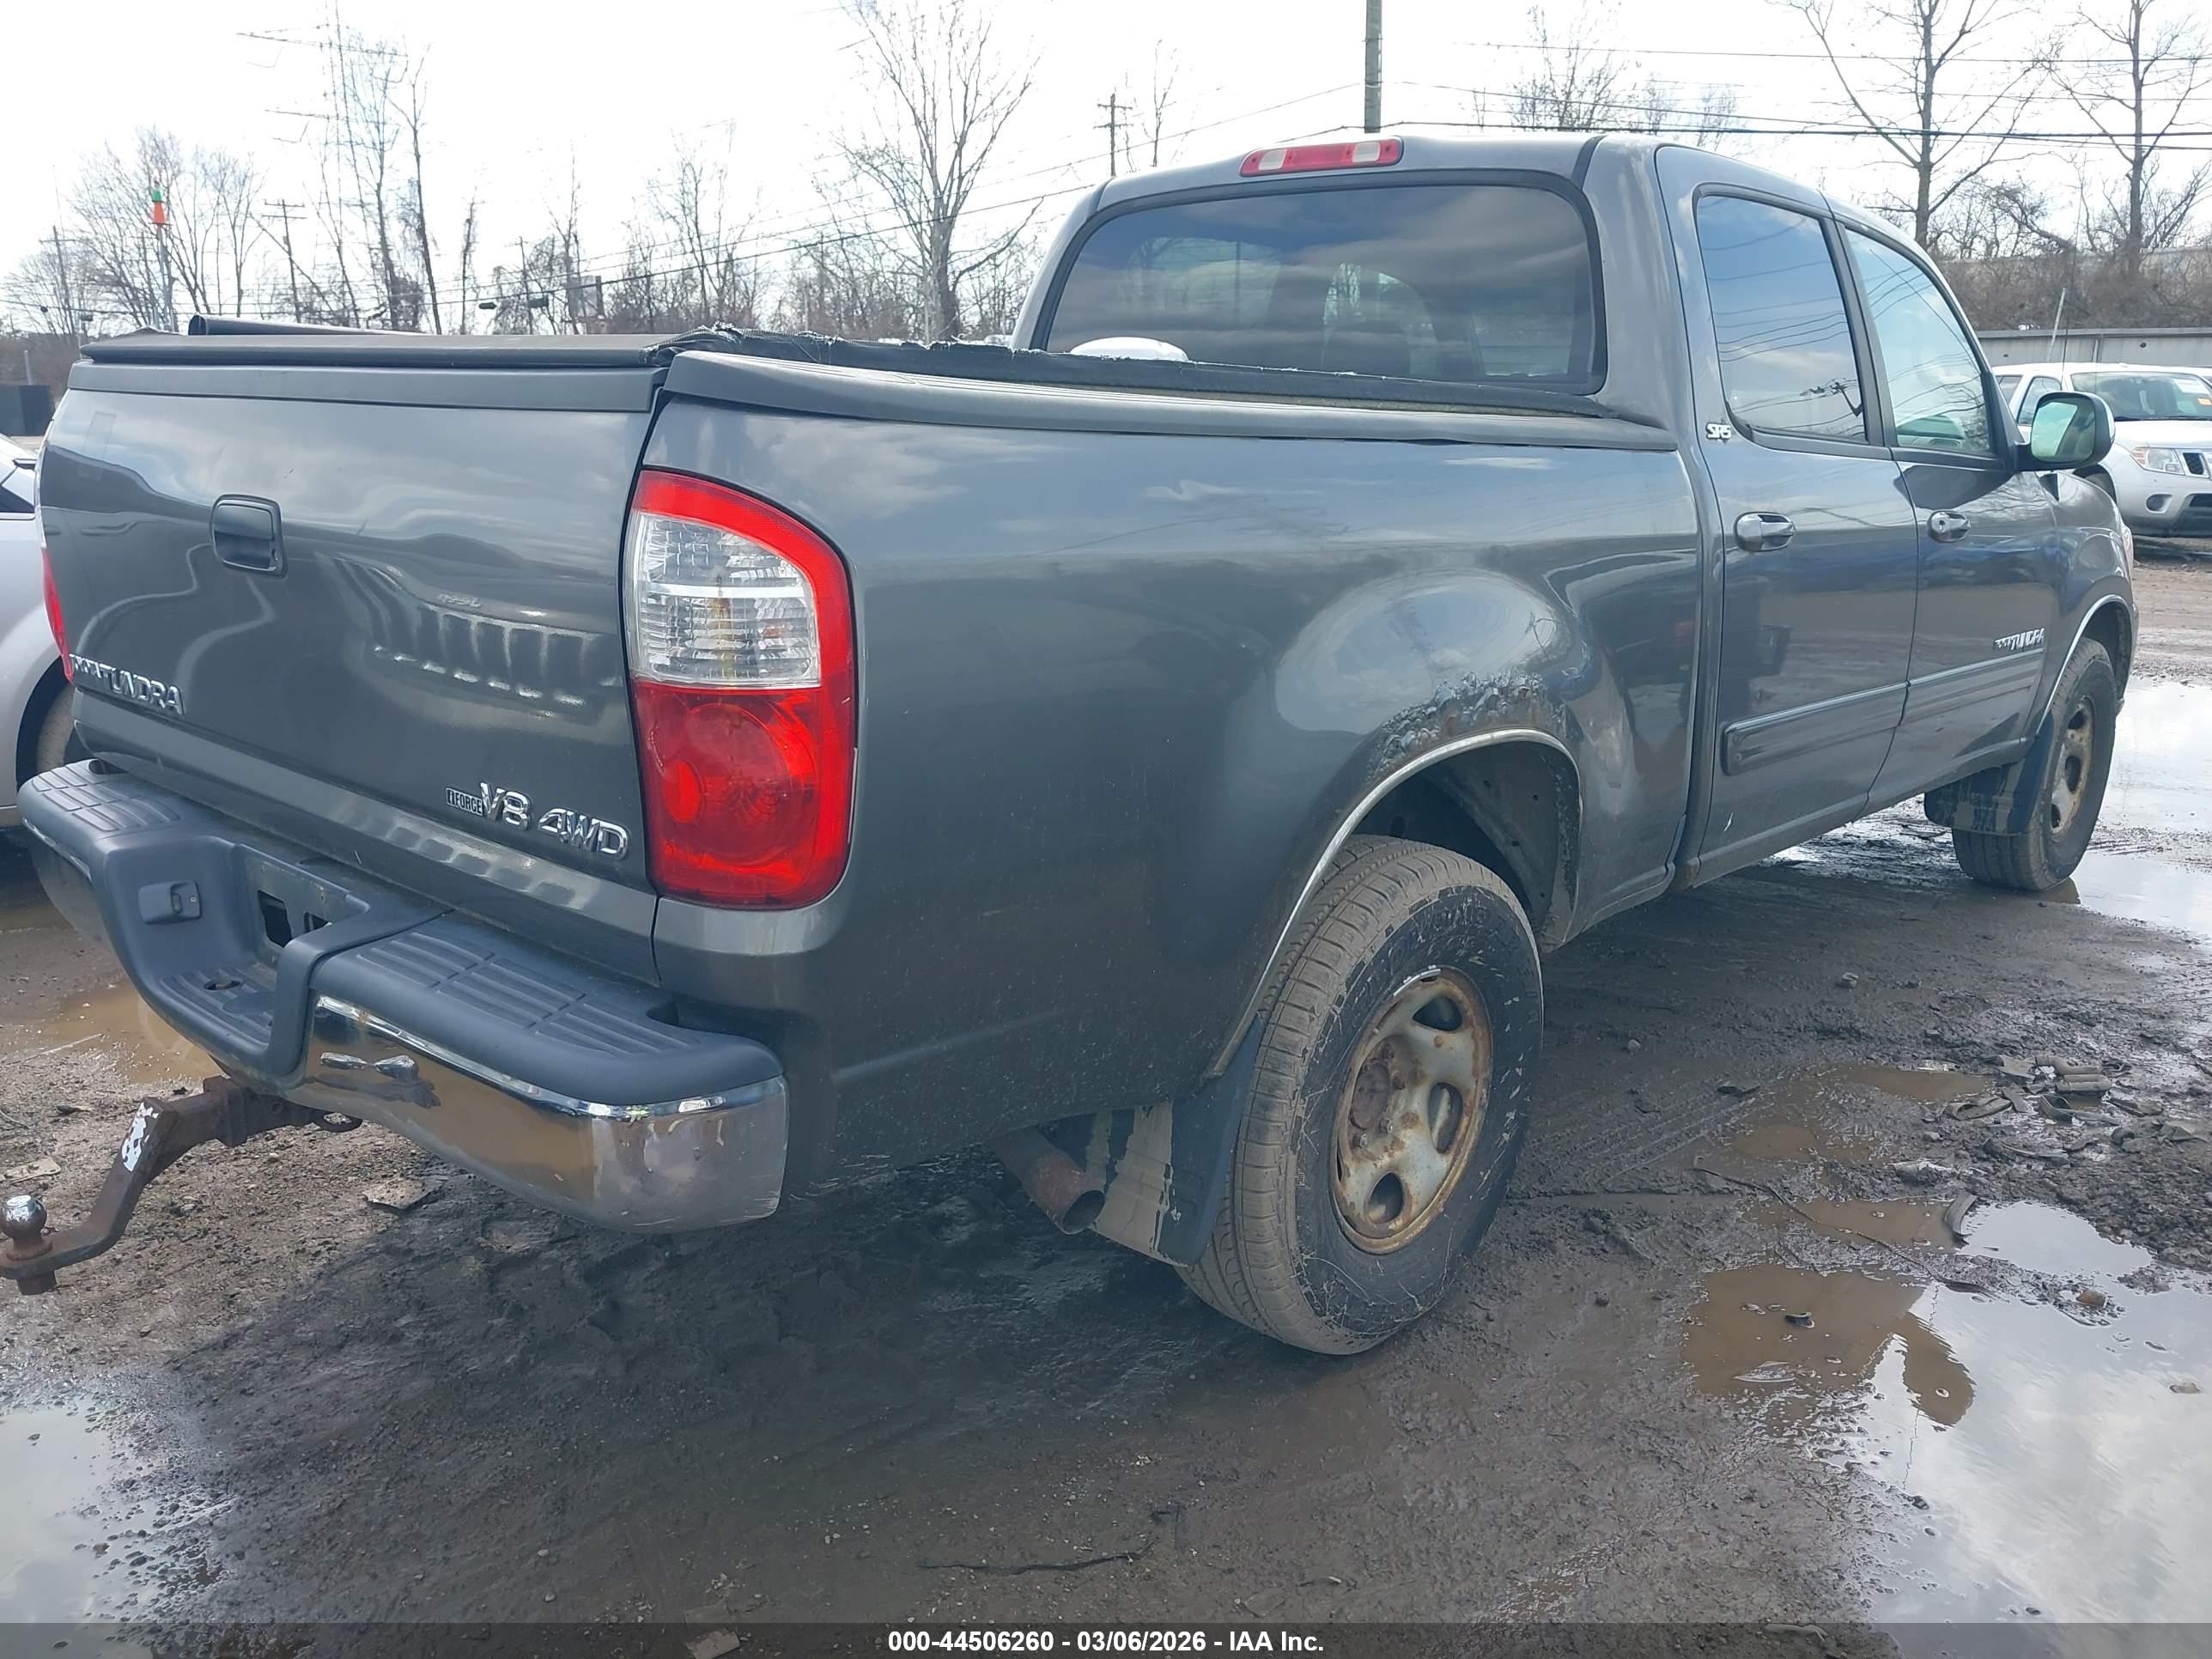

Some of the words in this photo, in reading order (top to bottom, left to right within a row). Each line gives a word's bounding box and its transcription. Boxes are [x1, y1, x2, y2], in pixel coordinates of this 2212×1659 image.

[1706, 422, 1732, 440] SR5
[98, 662, 186, 715] TUNDRA
[479, 781, 532, 831] V8
[537, 807, 630, 861] 4WD
